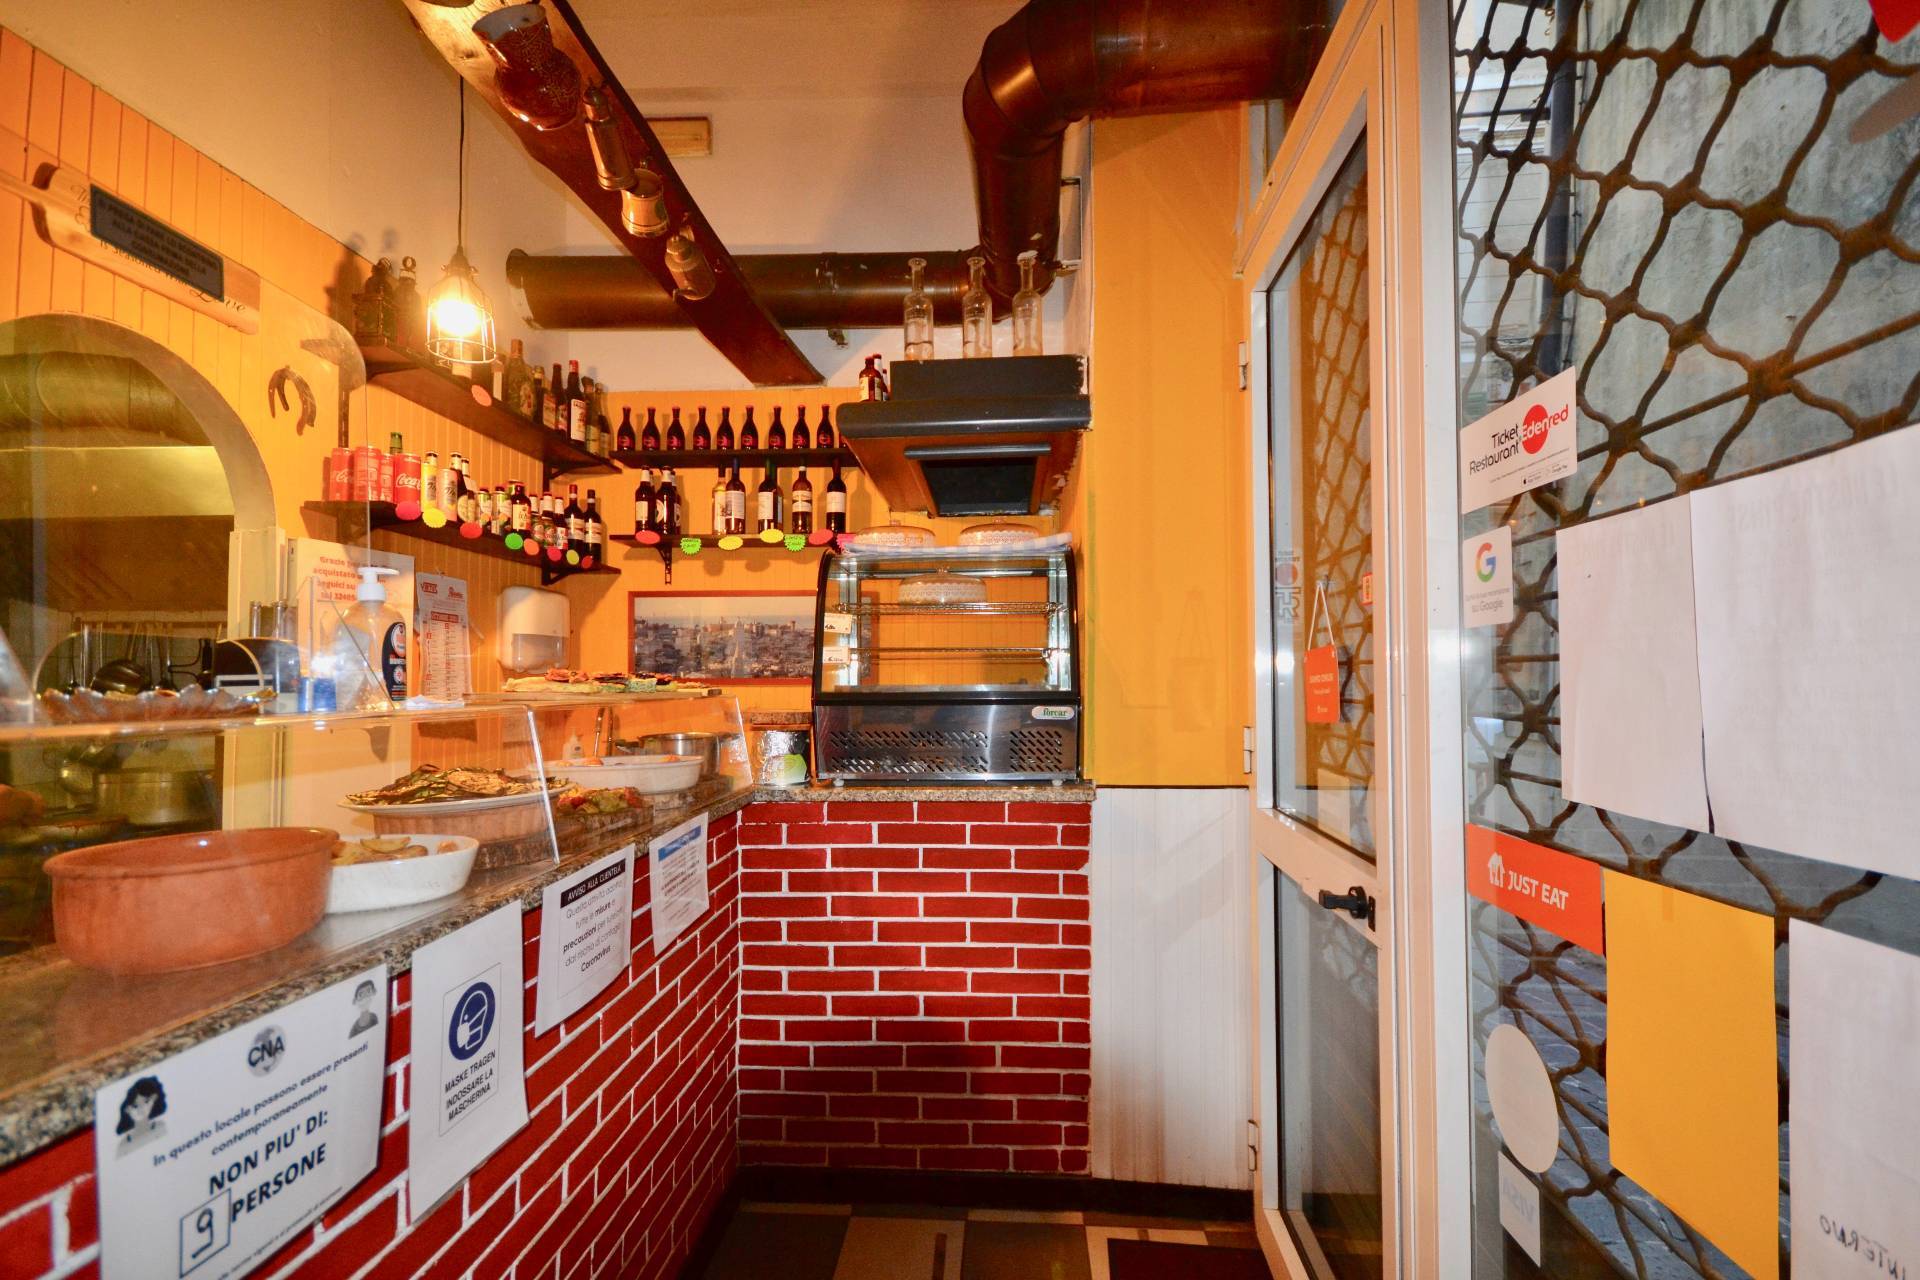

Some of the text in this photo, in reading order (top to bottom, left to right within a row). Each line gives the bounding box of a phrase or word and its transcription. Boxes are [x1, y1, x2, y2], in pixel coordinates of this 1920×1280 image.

[1492, 424, 1519, 449] Ticket
[1522, 404, 1569, 441] Edenred
[1469, 440, 1520, 476] Restaurant
[1476, 543, 1496, 582] G
[568, 865, 621, 902] AVVISO ALLA CLIENTELA
[1508, 870, 1569, 911] JUST EAT
[594, 901, 611, 916] misure
[563, 923, 597, 955] precauzioni
[581, 945, 611, 972] Coronavirus
[247, 1036, 286, 1068] CNA
[445, 1049, 496, 1094] MASKE TRAGEN
[153, 1041, 369, 1167] In questo locale possono essere presenti
[446, 1067, 493, 1110] INDOSSARE LA
[448, 1082, 491, 1122] MASCHERINA
[211, 1084, 329, 1157] contemporaneamente
[209, 1110, 329, 1195] NON PIU' DI:
[231, 1143, 327, 1224] PERSONE
